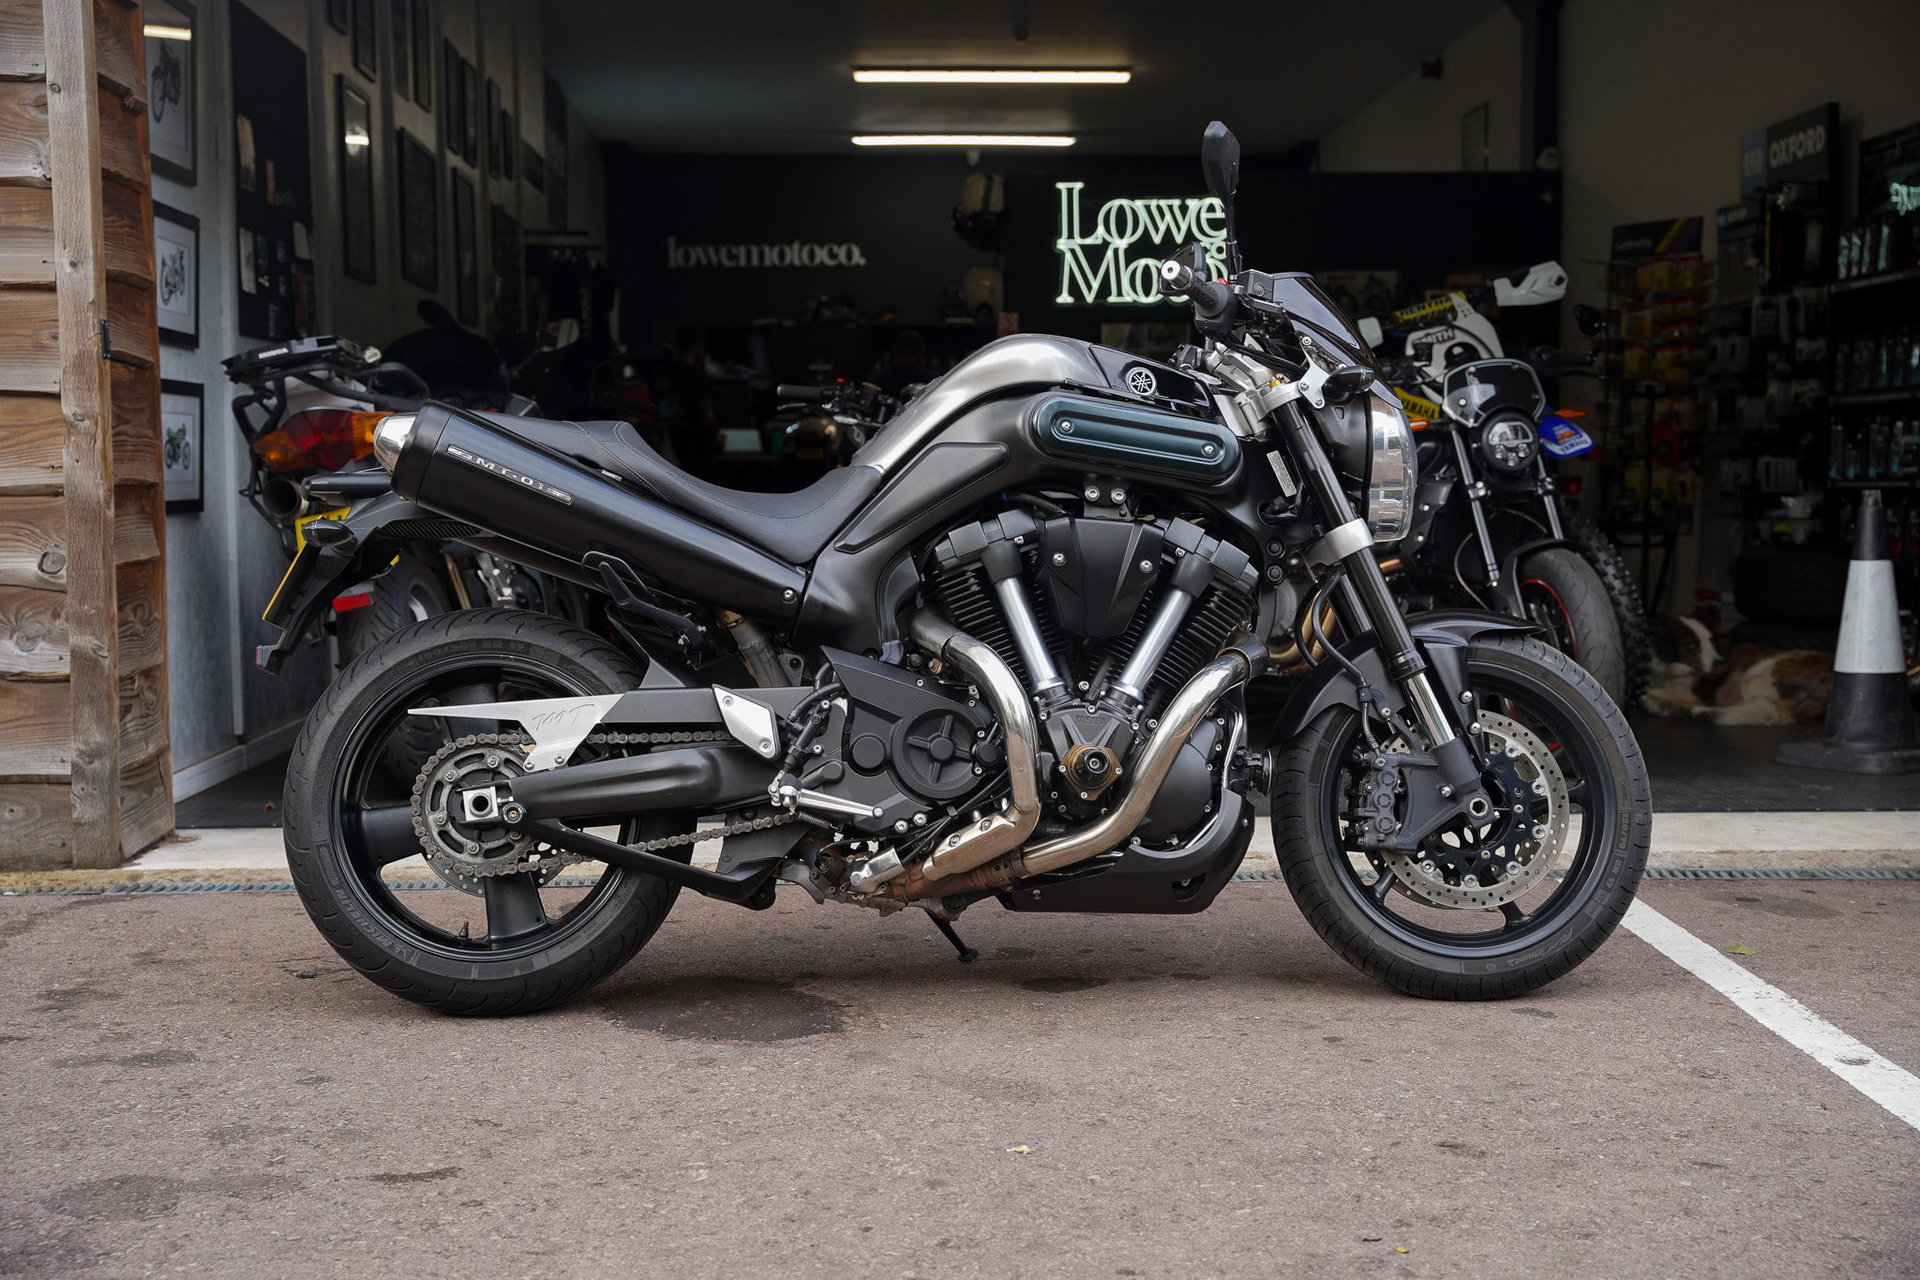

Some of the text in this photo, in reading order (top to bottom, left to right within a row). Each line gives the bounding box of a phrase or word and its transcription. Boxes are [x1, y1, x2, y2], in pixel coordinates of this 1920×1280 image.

[1769, 125, 1827, 168] OXFORD
[1056, 182, 1227, 245] Lowe
[665, 235, 868, 269] lowemotoco.
[475, 457, 545, 491] MT-01
[334, 886, 393, 949] MICHELIN
